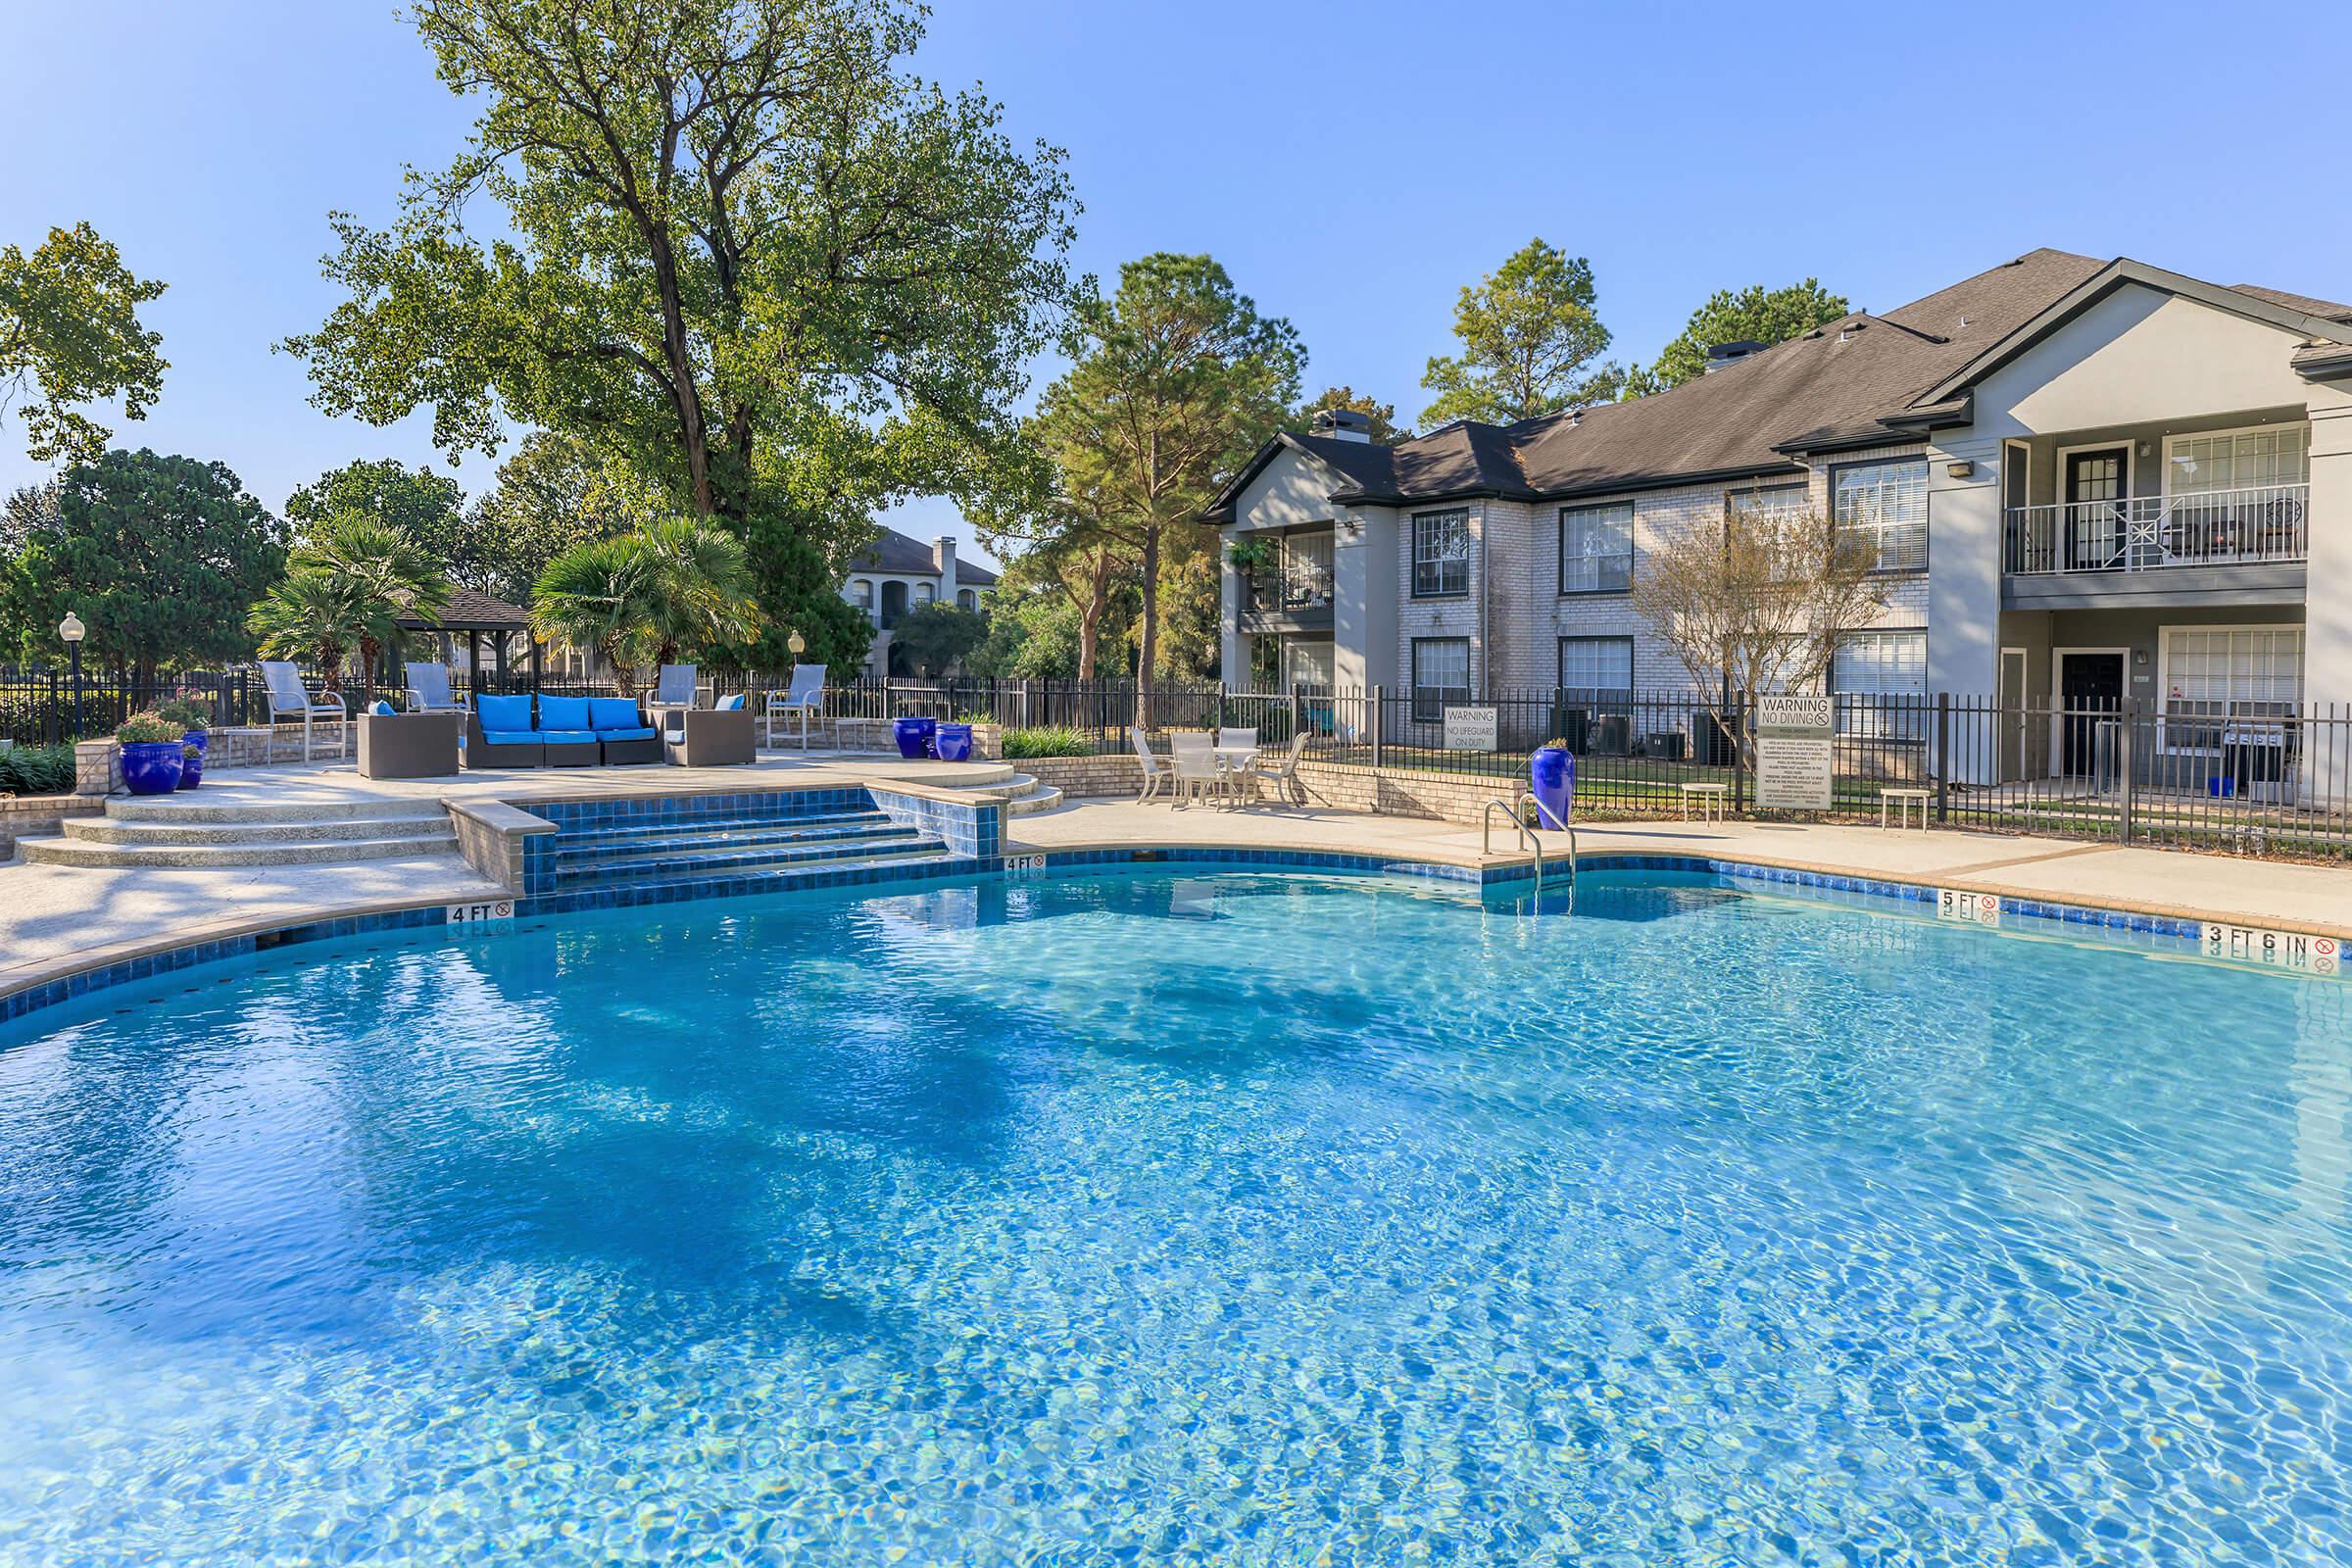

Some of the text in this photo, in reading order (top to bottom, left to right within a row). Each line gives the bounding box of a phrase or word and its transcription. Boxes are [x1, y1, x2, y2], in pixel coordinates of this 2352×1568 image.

[1764, 699, 1828, 712] WARNING
[1447, 710, 1494, 722] WARNING
[1762, 712, 1814, 725] NO DIVING
[1446, 726, 1494, 736] NO LIFEGUARD
[1455, 737, 1486, 747] ON DUTY
[1007, 857, 1032, 870] 4 FT
[1943, 892, 1977, 908] 5 FT
[453, 905, 491, 922] 4 FT
[2210, 926, 2306, 954] 3 FT 6 IN
